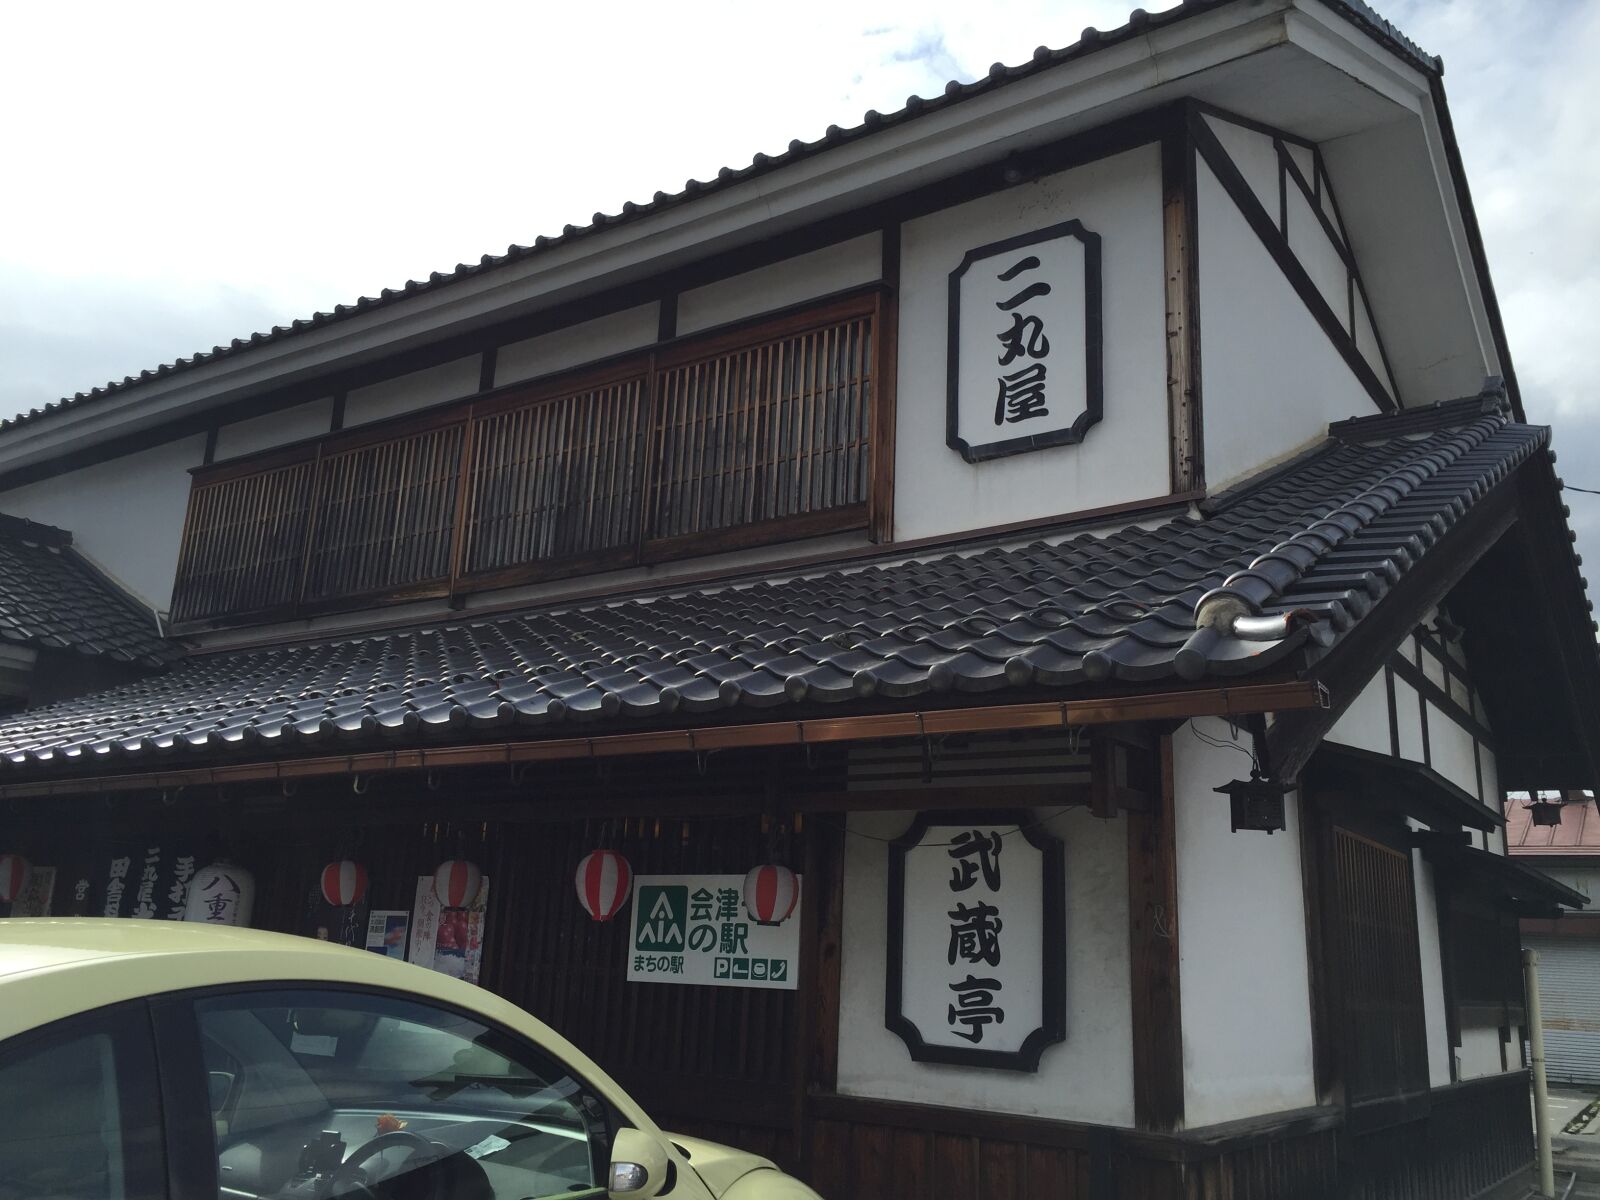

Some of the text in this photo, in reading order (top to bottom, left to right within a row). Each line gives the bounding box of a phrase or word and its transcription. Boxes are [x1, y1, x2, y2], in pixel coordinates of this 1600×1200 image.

[994, 256, 1051, 425] 二丸屋
[202, 874, 241, 920] 八重
[688, 922, 748, 954] の駅
[948, 830, 1004, 1043] 武蔵亭
[633, 955, 684, 974] まちの駅
